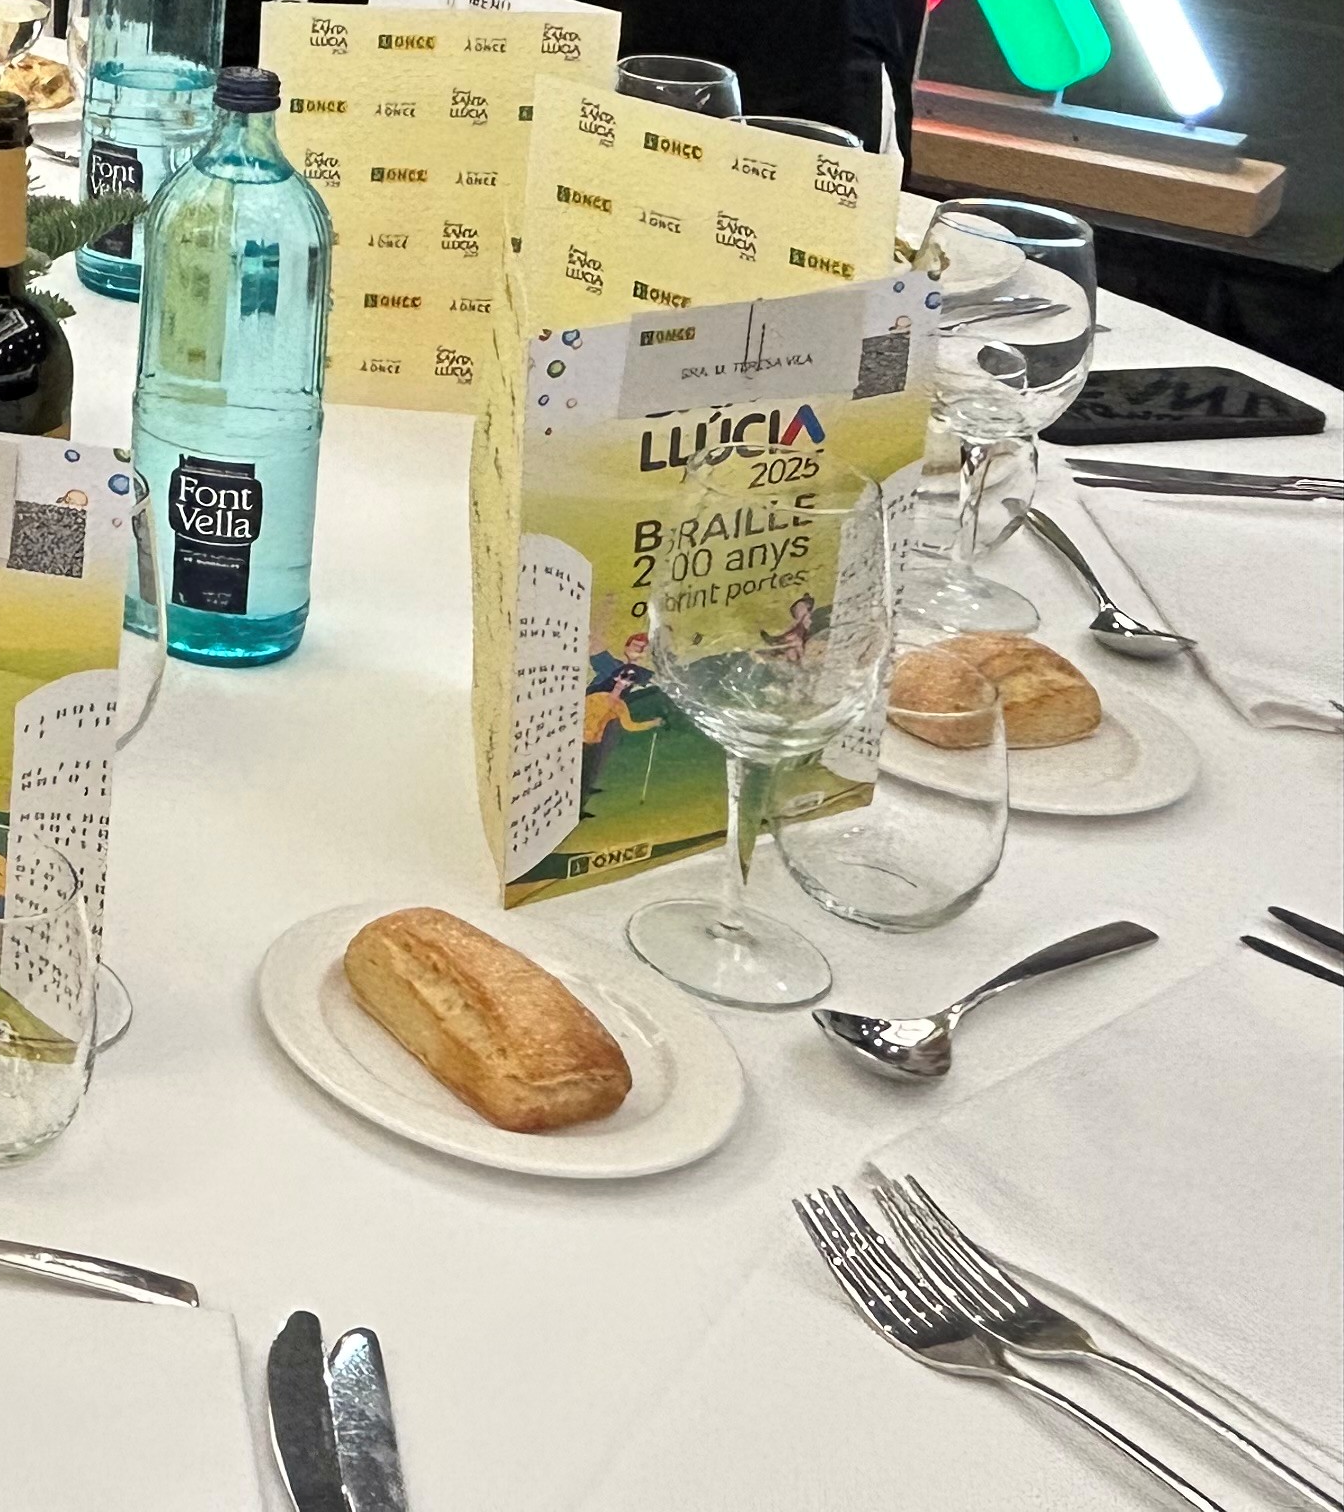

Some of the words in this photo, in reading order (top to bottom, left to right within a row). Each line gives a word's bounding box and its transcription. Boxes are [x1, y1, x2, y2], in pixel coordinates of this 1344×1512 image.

[92, 154, 135, 184] Font
[640, 404, 826, 473] LLÚCIA
[748, 456, 820, 490] 2025
[178, 474, 253, 511] Font
[175, 503, 252, 539] Vella
[634, 492, 817, 554] BRAILLE
[631, 548, 712, 588] 200
[725, 535, 811, 572] anys
[725, 569, 809, 606] portes
